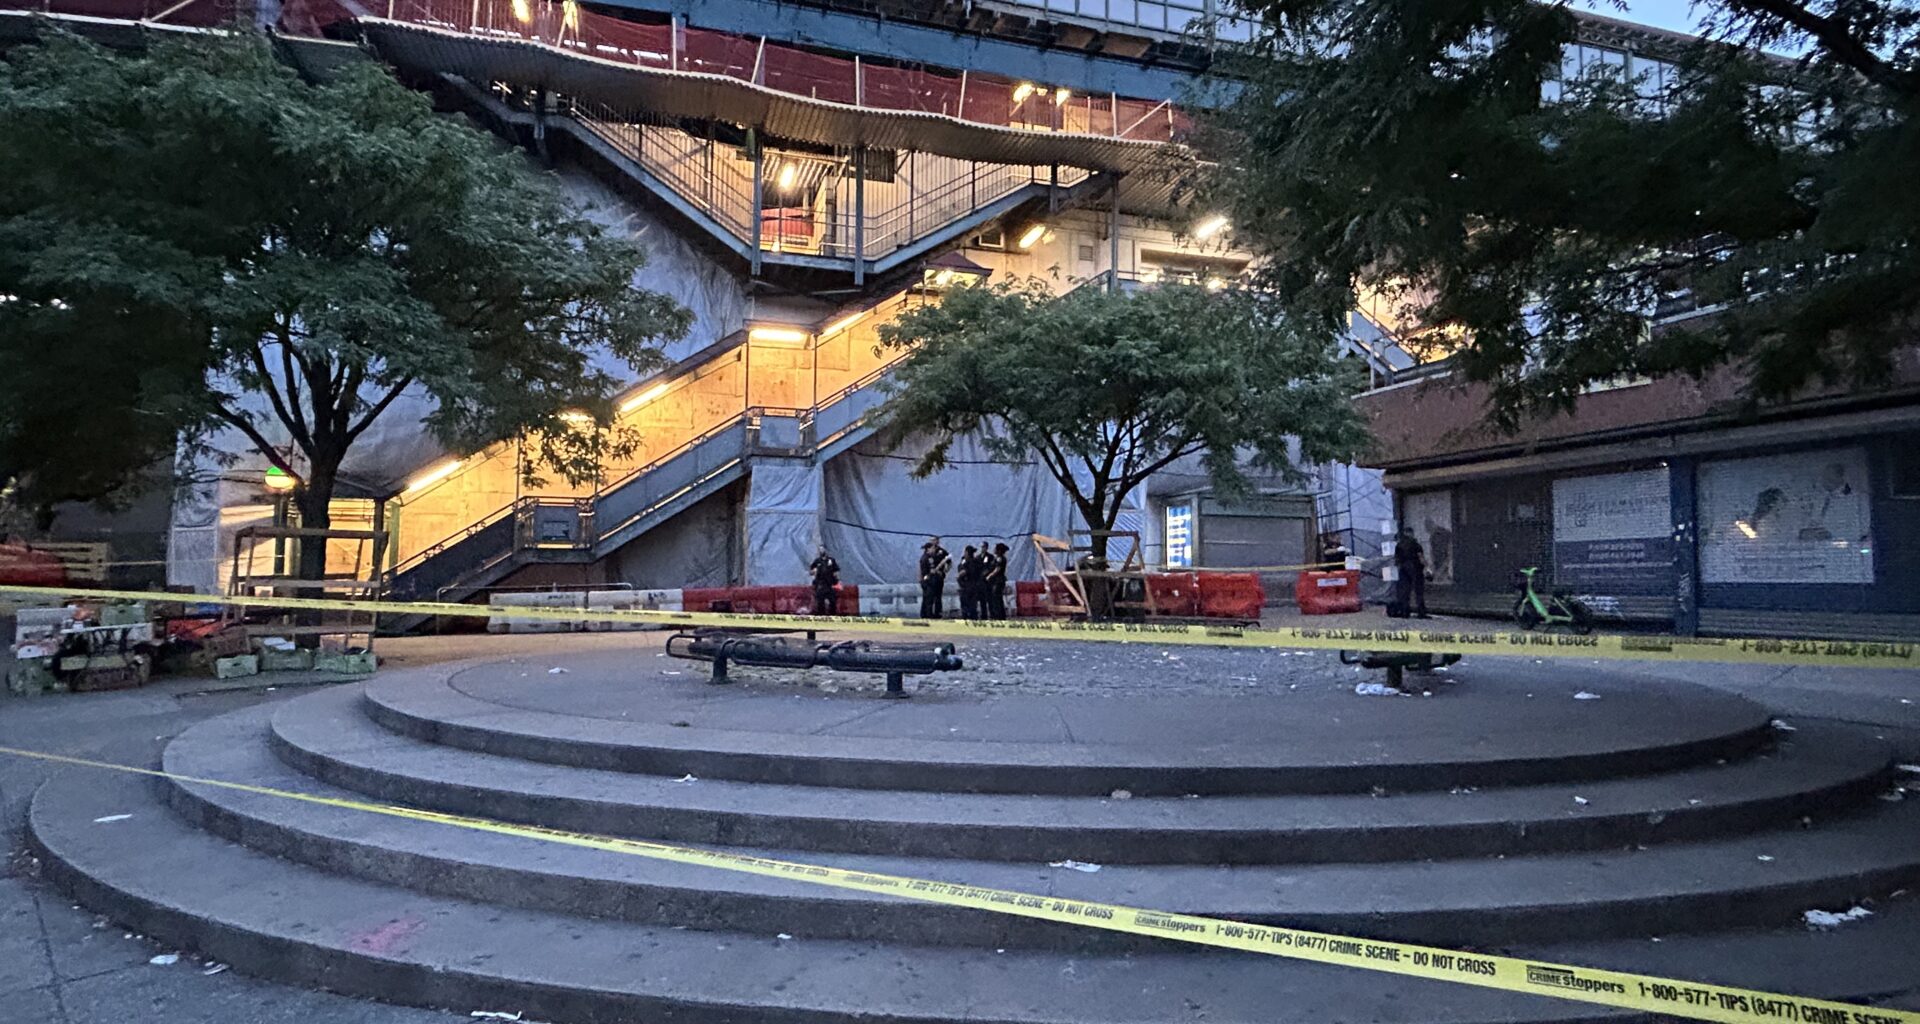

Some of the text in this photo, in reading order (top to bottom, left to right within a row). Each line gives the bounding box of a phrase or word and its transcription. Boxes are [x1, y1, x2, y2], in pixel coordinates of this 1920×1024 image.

[1066, 903, 1084, 917] NOT
[1084, 906, 1115, 920] CROSS
[1215, 924, 1293, 946] 1-800-577-TIPS
[1294, 932, 1327, 951] (8477)
[1328, 939, 1362, 956] CRIME
[1365, 945, 1400, 962] SCENE
[1413, 951, 1429, 966] DO
[1431, 953, 1454, 970] NOT
[1457, 958, 1496, 976] CROSS
[1638, 981, 1749, 1013] 1-800-577-TIPS
[1751, 996, 1799, 1022] (8477)
[1801, 1005, 1850, 1024] CRIME
